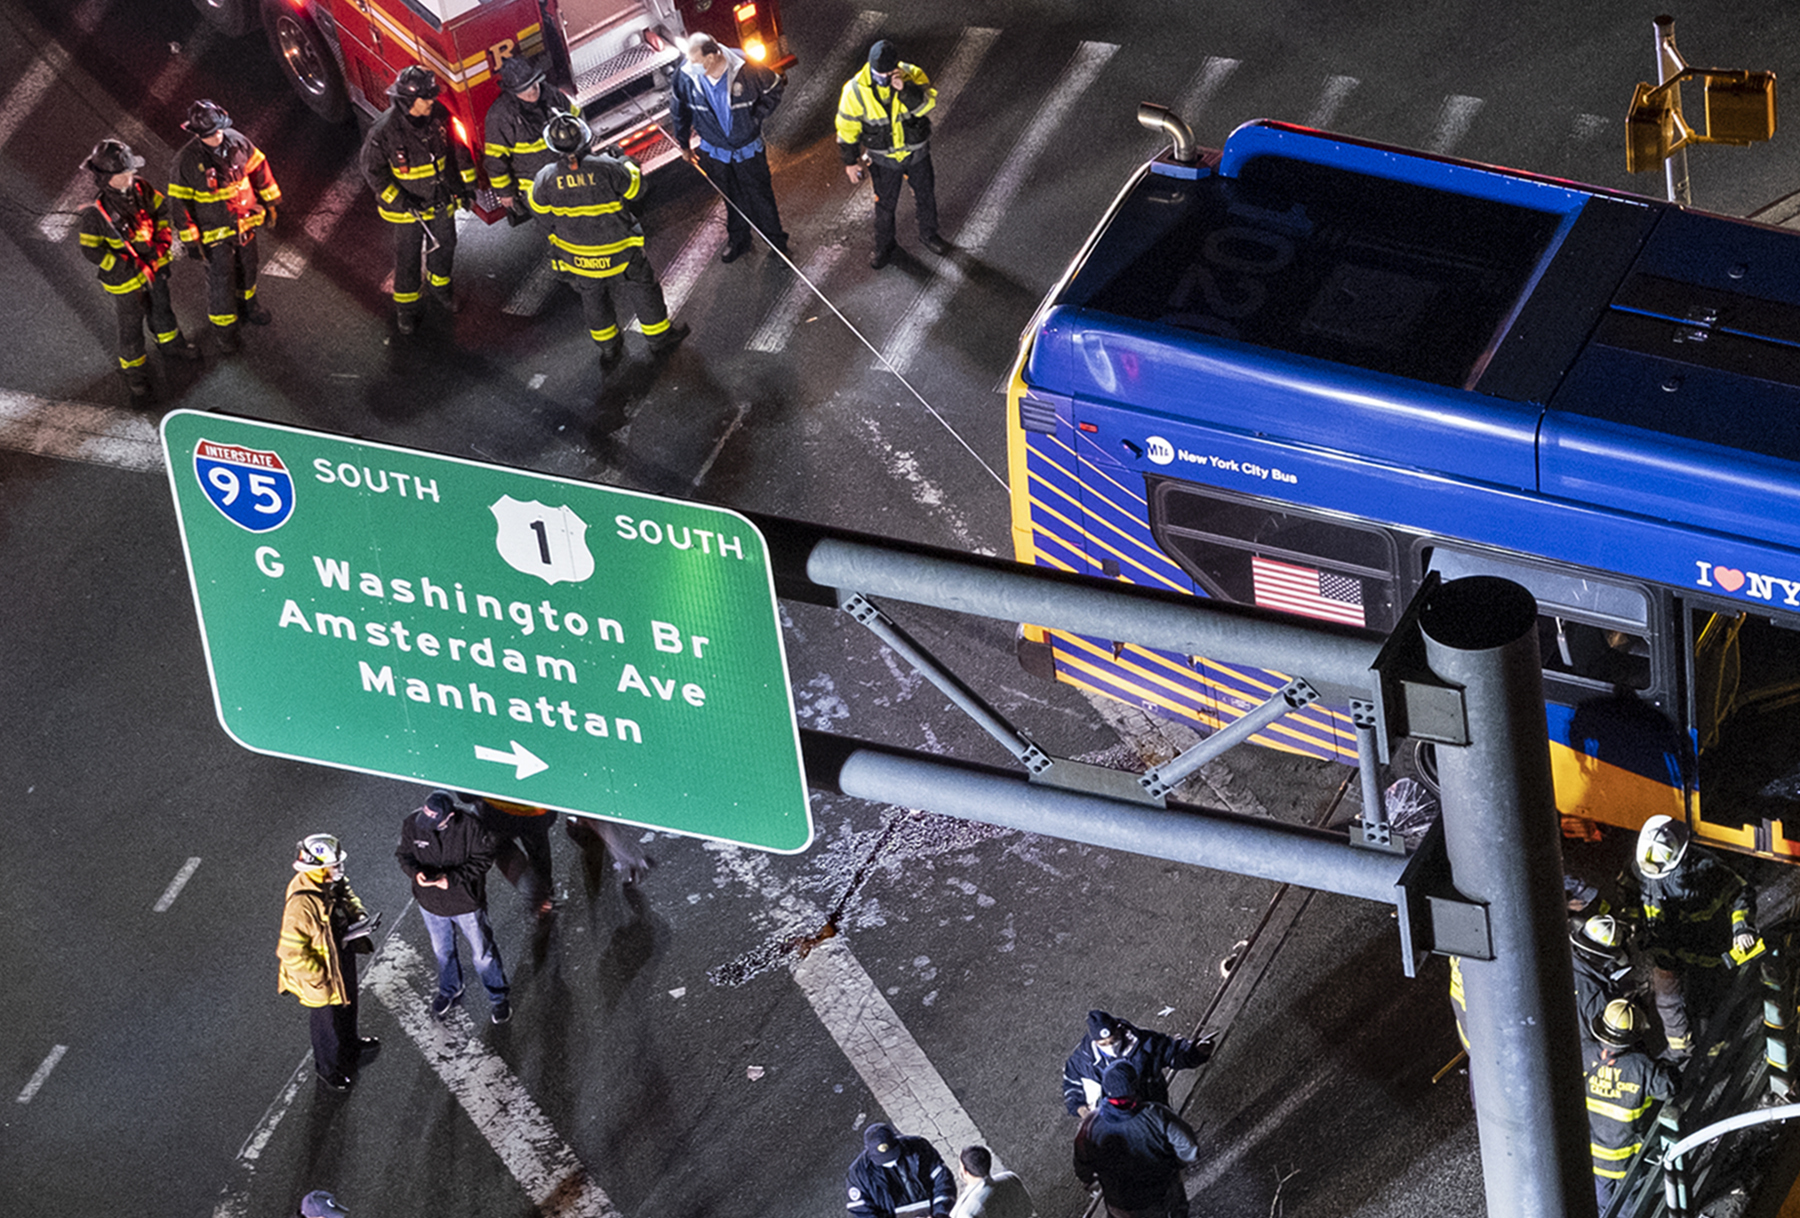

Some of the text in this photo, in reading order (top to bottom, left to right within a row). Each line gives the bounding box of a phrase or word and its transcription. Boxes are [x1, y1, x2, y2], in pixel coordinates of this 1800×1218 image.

[573, 256, 611, 270] CONROY
[204, 444, 274, 468] INTERSTATE
[1177, 449, 1299, 484] New York City Bus
[207, 466, 283, 514] 95
[312, 458, 441, 503] SOUTH
[529, 519, 552, 566] 1
[614, 514, 744, 560] SOUTH
[1695, 560, 1713, 588] I
[254, 545, 709, 659] G Washington Br
[278, 599, 707, 707] Amsterdam Ave
[358, 660, 643, 744] Manhattan
